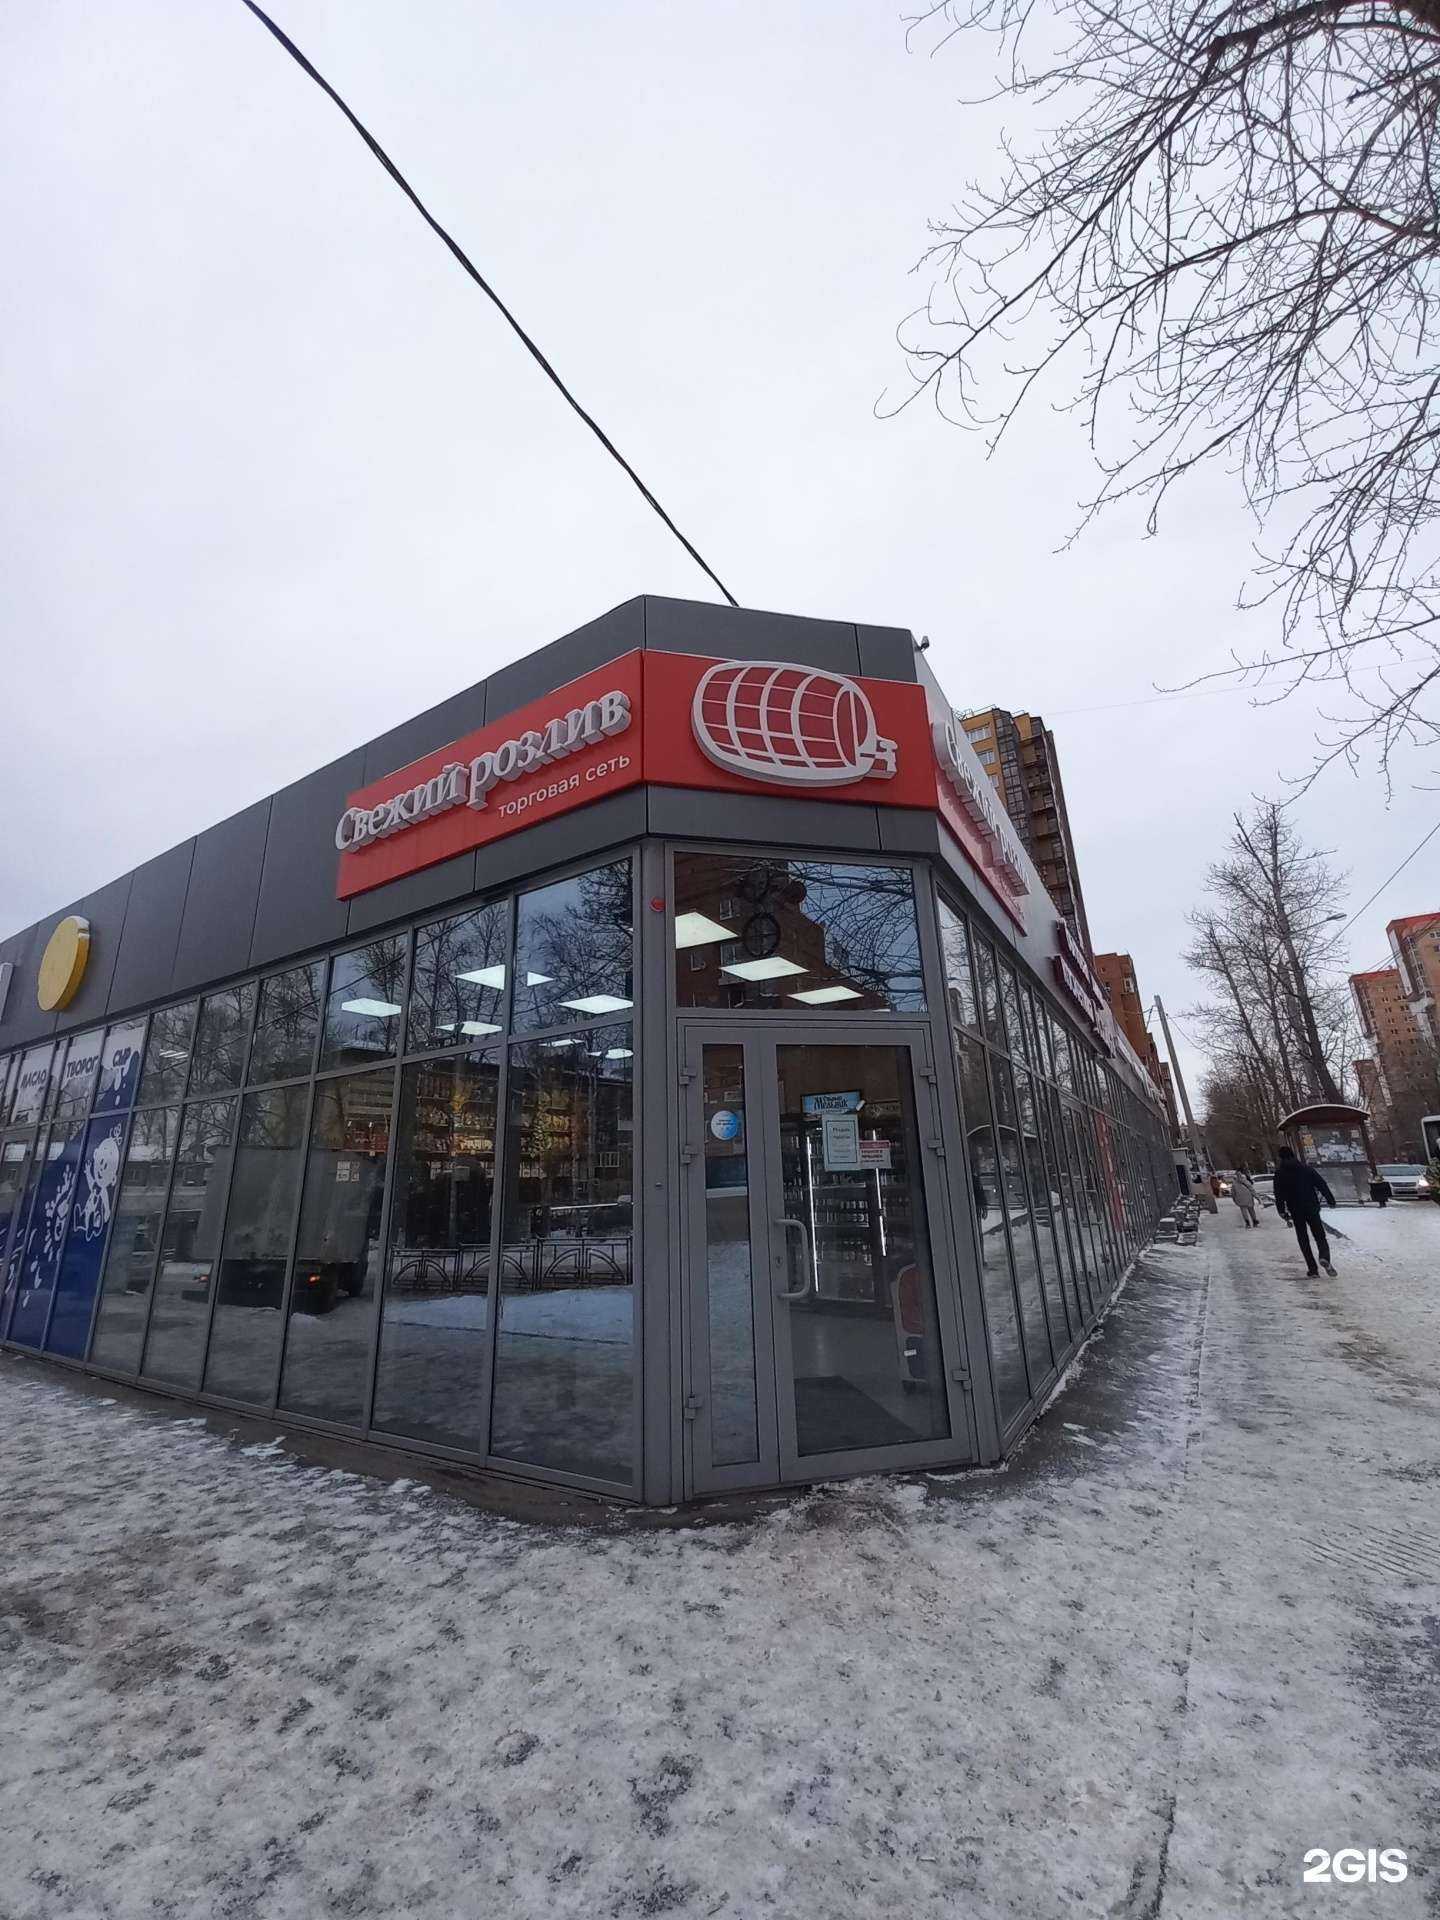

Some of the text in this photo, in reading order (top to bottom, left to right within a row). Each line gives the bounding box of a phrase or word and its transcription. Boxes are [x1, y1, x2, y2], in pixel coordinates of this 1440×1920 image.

[335, 690, 632, 852] Свежий розлив
[498, 753, 630, 818] торговая сеть
[66, 1055, 99, 1078] ТВОРОГ
[112, 1046, 131, 1067] СЫР
[20, 1069, 47, 1089] МАСЛО
